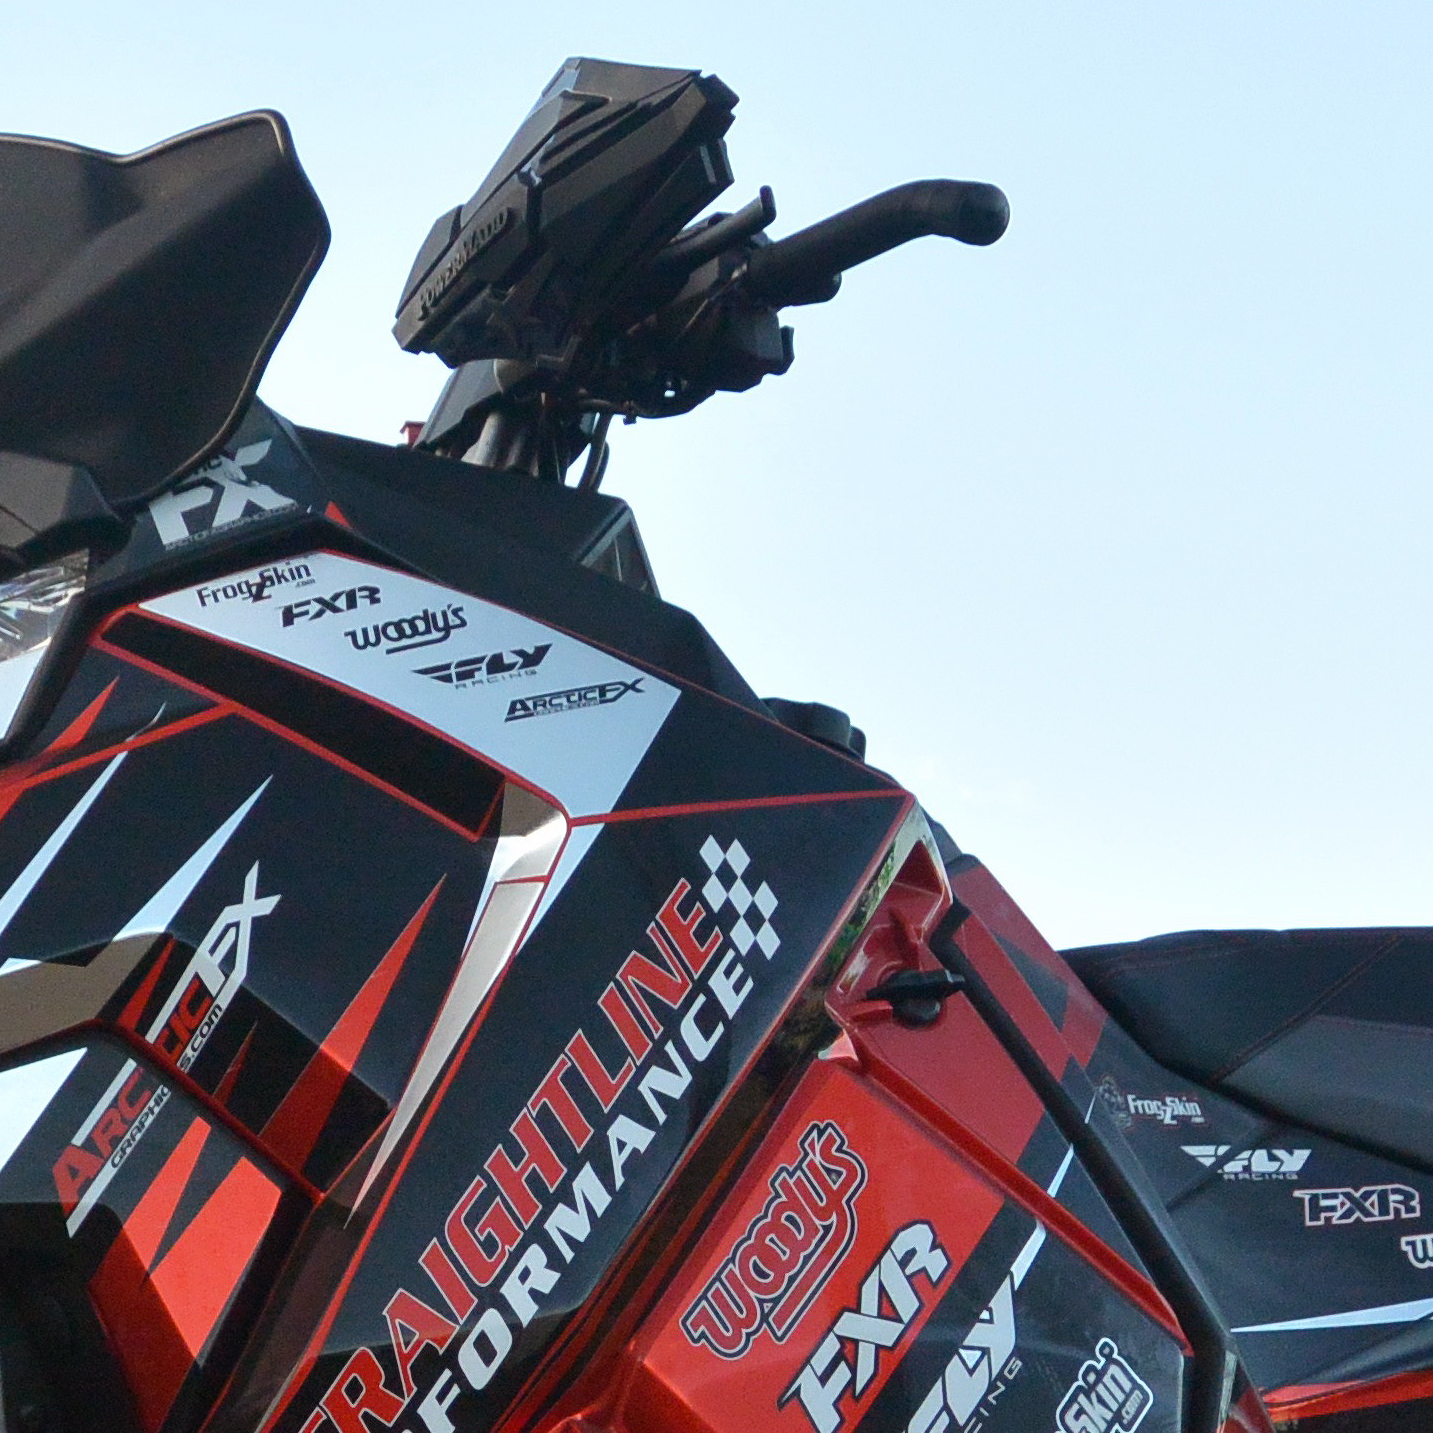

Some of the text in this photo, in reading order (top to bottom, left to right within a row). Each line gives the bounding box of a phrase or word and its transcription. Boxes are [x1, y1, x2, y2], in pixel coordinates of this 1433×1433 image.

[280, 585, 382, 628] FXR
[429, 643, 553, 684] FLY
[455, 668, 537, 690] RACING
[1199, 1146, 1312, 1172] FLY
[1293, 1184, 1420, 1226] FXR
